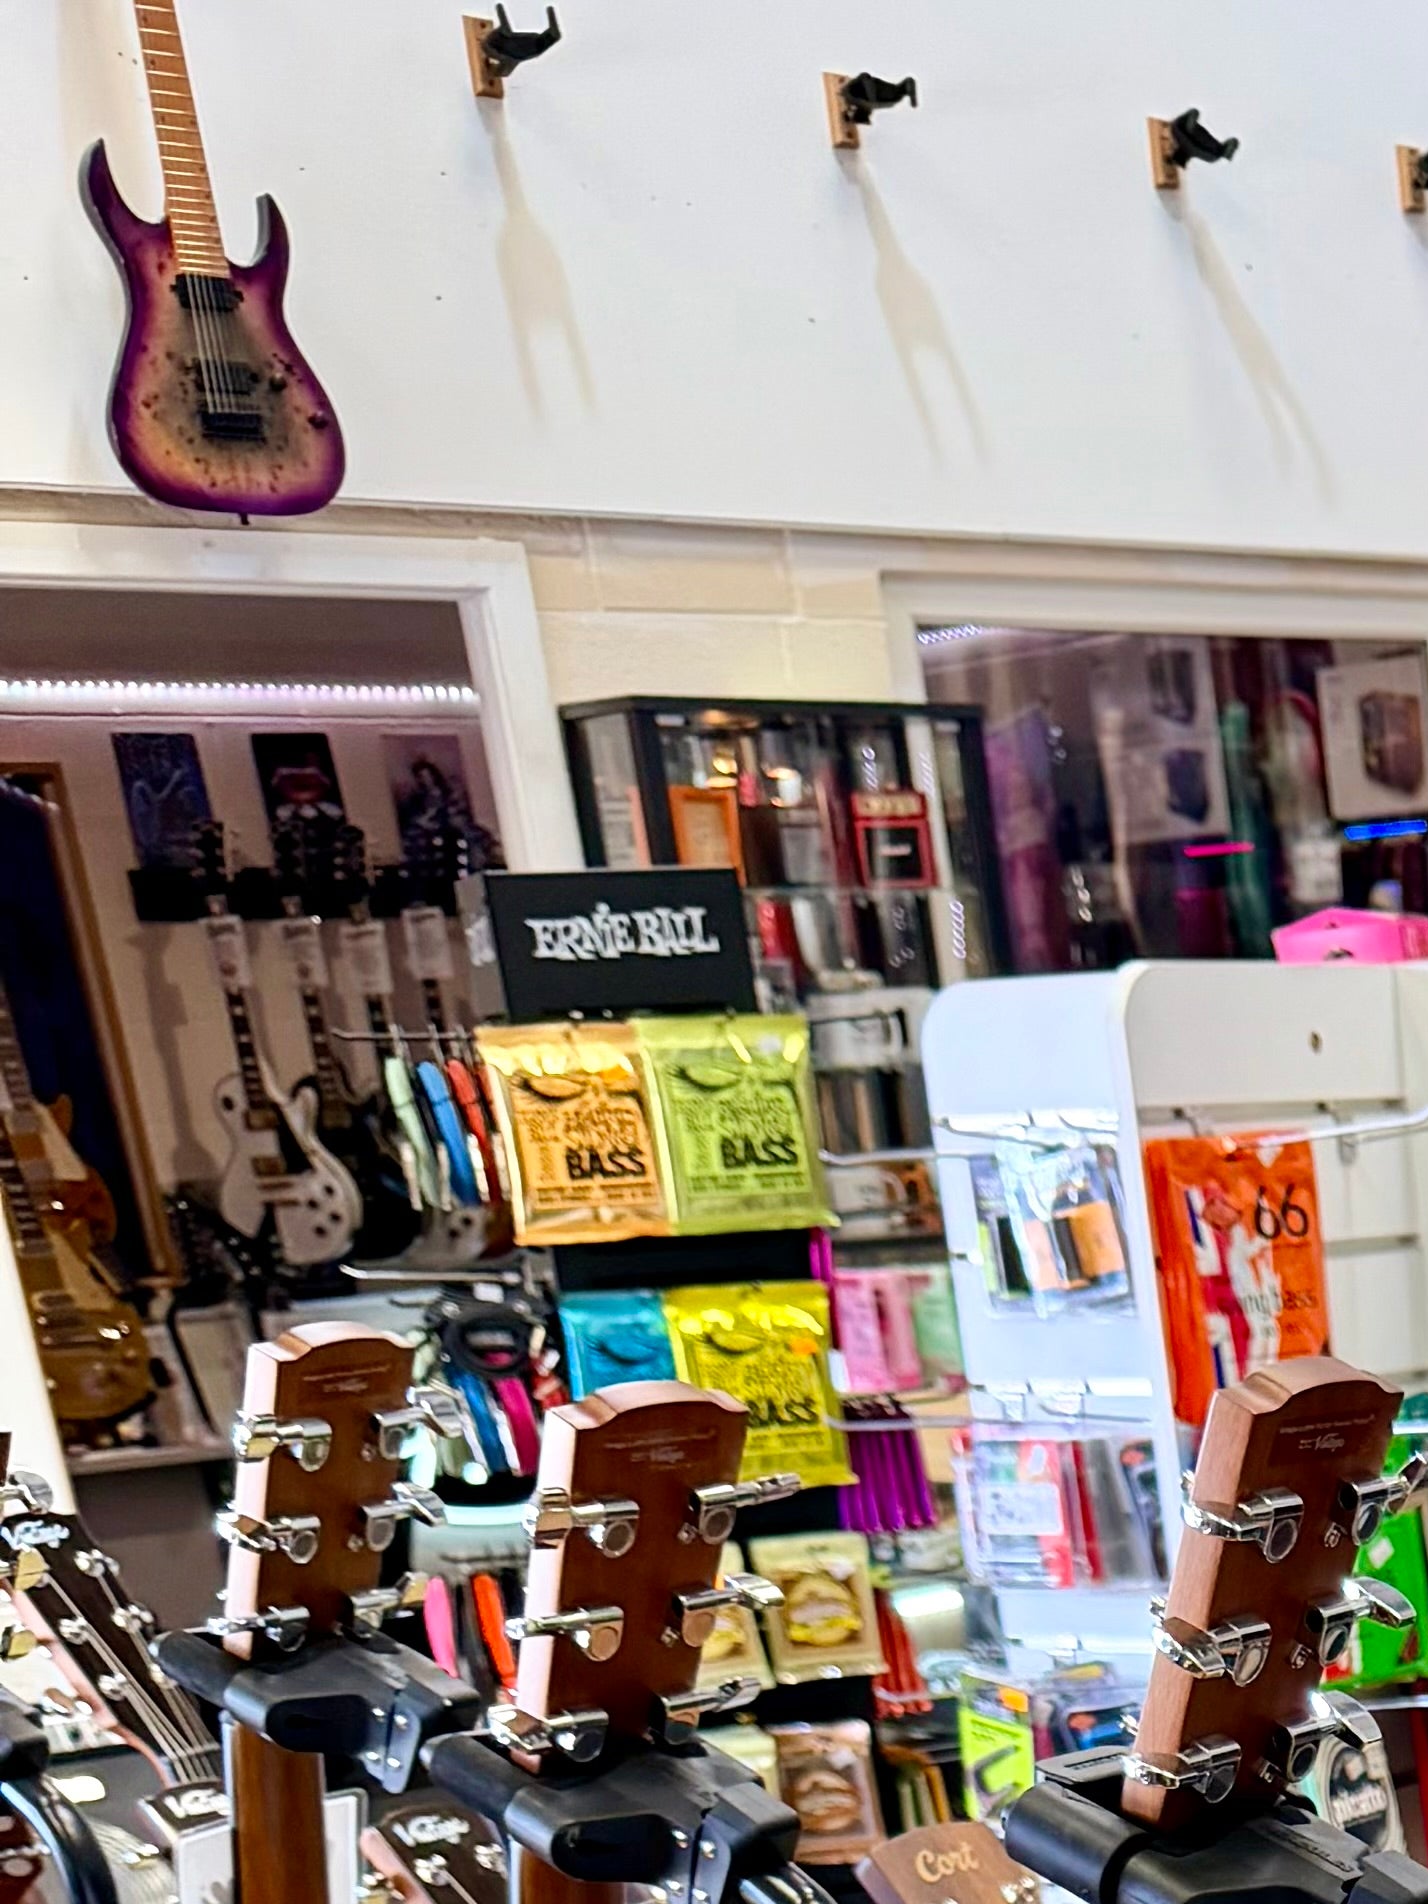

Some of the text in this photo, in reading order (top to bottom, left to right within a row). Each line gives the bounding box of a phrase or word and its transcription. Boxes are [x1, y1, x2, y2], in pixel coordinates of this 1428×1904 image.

[525, 902, 720, 961] ERNIE BALL
[566, 1146, 646, 1180] BASS
[720, 1136, 798, 1169] BASS
[1254, 1183, 1309, 1239] 66
[914, 1843, 979, 1884] Cort
